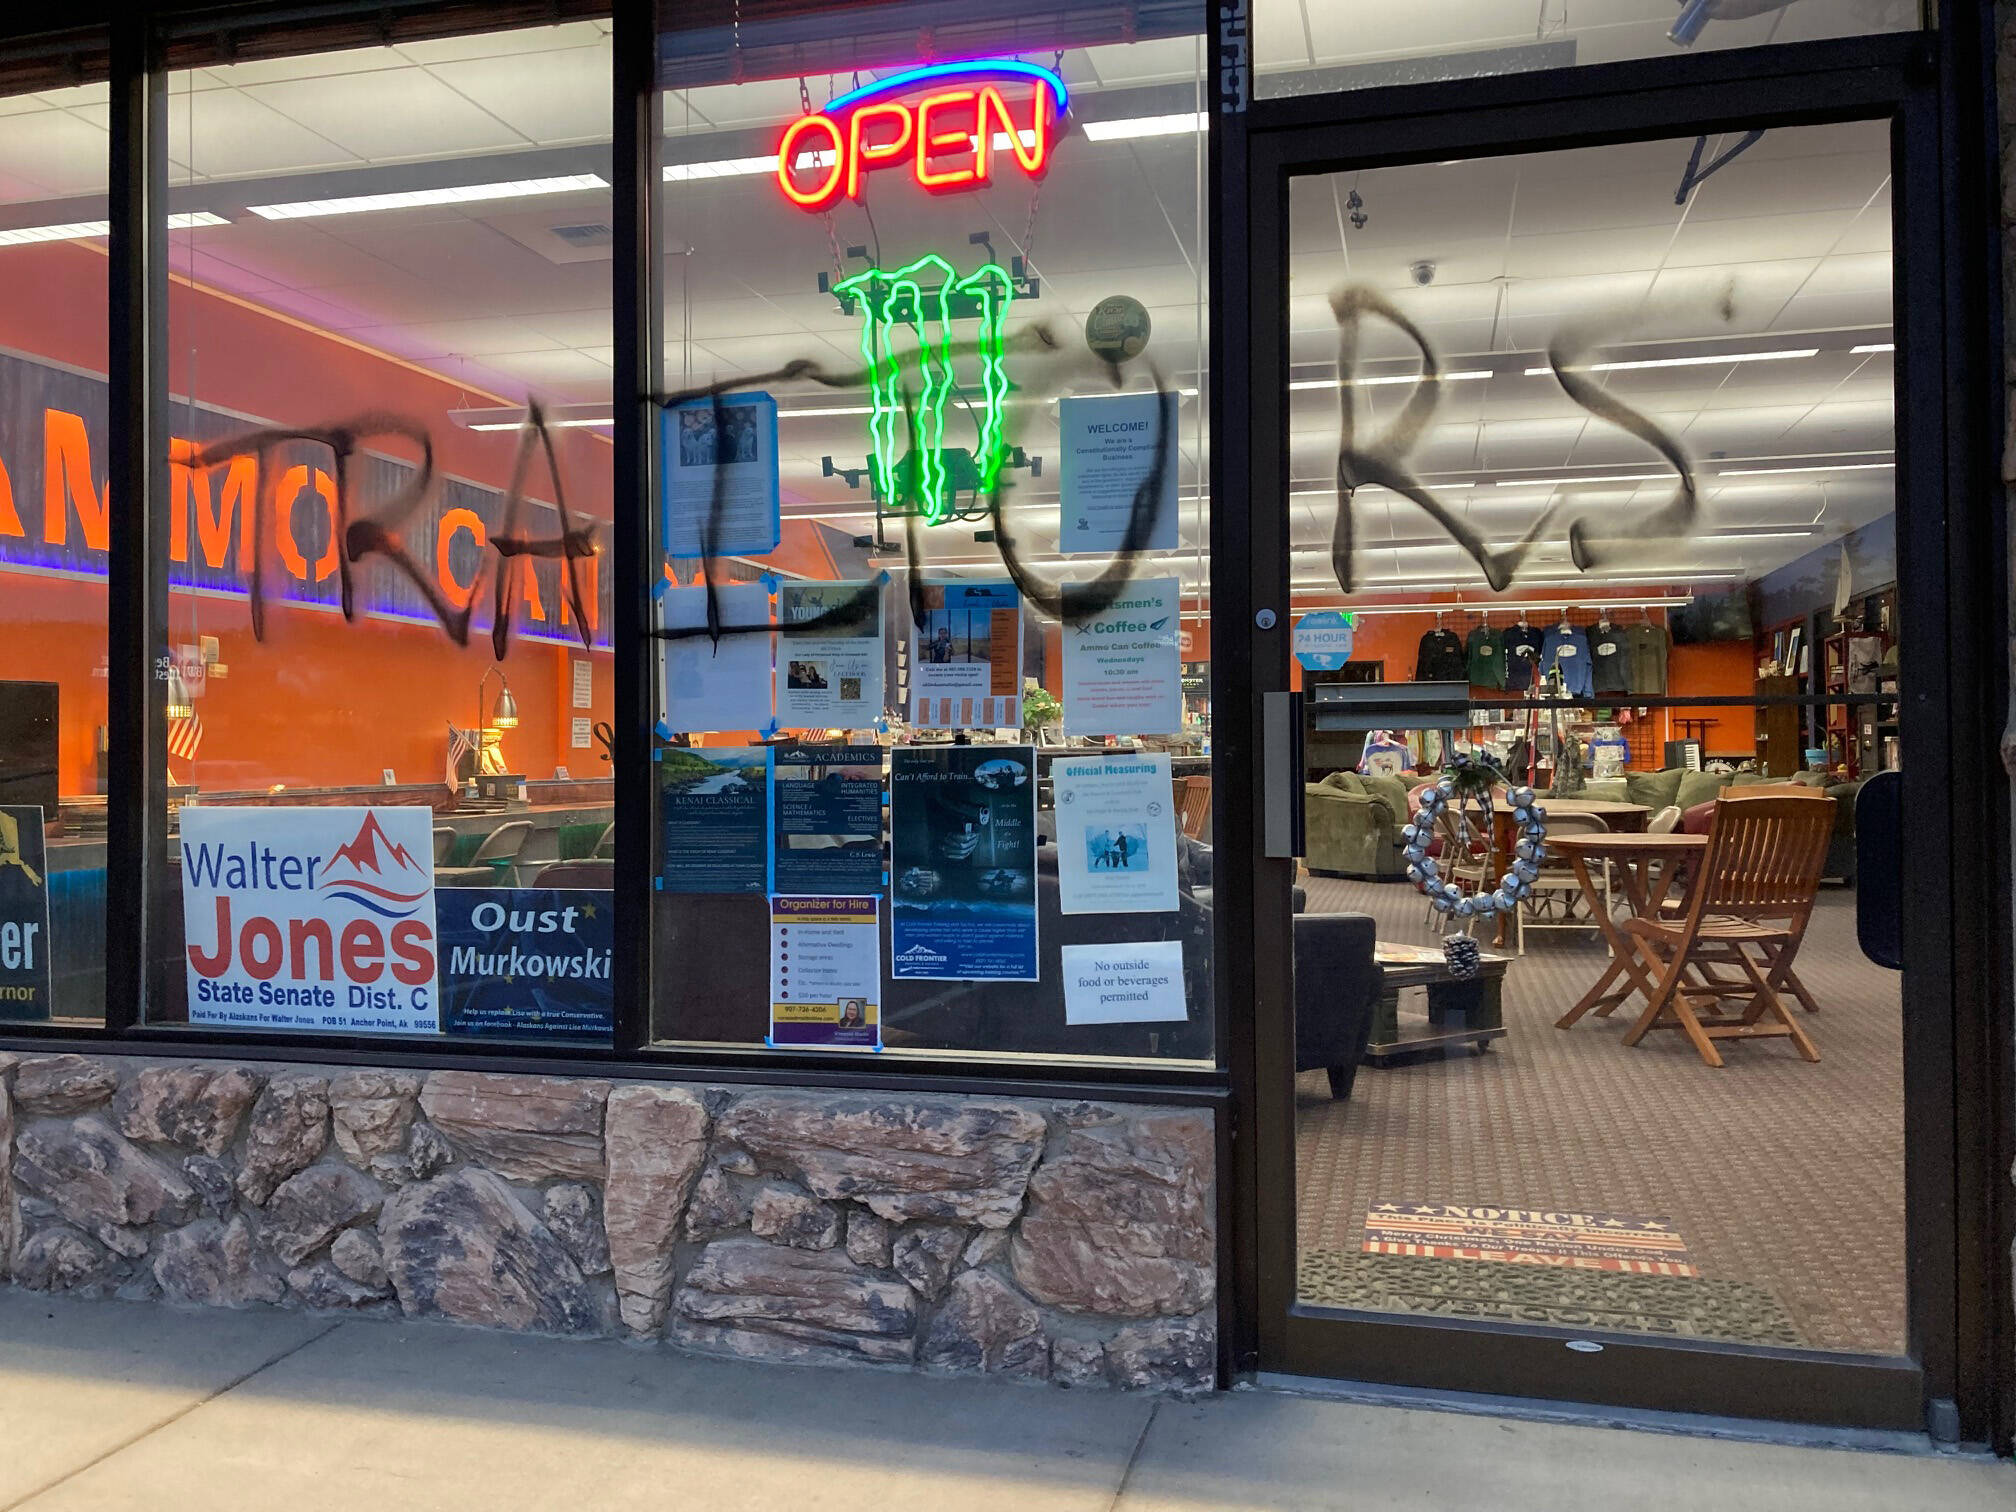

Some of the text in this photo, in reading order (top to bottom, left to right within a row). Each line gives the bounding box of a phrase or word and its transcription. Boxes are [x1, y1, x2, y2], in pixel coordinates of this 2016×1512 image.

[777, 79, 1048, 209] OPEN
[1087, 421, 1149, 434] WELCOME!
[1094, 620, 1147, 634] Coffee
[1298, 632, 1346, 643] 24 HOUR
[1080, 641, 1161, 652] Ammo Can Coffee
[1097, 655, 1145, 664] Wednesdays
[815, 752, 876, 762] ACADEMICS
[895, 772, 915, 781] Can't
[916, 772, 938, 782] Afford
[1066, 764, 1157, 777] Official Measuring
[675, 796, 753, 805] KENAI CLASSICAL
[995, 818, 1022, 827] Middle
[998, 841, 1020, 850] Fight!
[184, 840, 321, 890] Walter
[780, 899, 869, 912] Organizer for Hire
[471, 901, 579, 934] Oust
[187, 895, 435, 985] Jones
[450, 946, 612, 979] Murkowski
[895, 954, 948, 963] COLD FRONTIER
[1095, 960, 1150, 971] No outside
[1078, 975, 1169, 988] food or beverages
[198, 978, 429, 1011] State Senate Dist. C
[1100, 990, 1149, 1005] permitted
[192, 1010, 437, 1030] Paid For By Alaskans For Walter Jones POB 51 Anchor Point, Ak 99556
[464, 1008, 478, 1016] Help
[487, 1009, 511, 1017] replace
[561, 1011, 605, 1019] Conservative.
[453, 1019, 467, 1027] Join
[484, 1020, 512, 1028] facebook
[516, 1022, 544, 1030] Alaskans
[544, 1023, 568, 1031] Against
[568, 1023, 581, 1031] Lisa
[1443, 1205, 1597, 1228] NOTICE
[1375, 1213, 1411, 1221] This
[1417, 1216, 1466, 1225] Place
[1492, 1220, 1579, 1234] Politically
[1586, 1226, 1670, 1240] Incorrect
[1462, 1225, 1580, 1242] WE SAY
[1381, 1229, 1669, 1257] Merry Christmas, One Nation Under God,
[1383, 1235, 1412, 1244] Give
[1415, 1238, 1459, 1248] Thanks
[1462, 1241, 1478, 1249] To
[1481, 1243, 1505, 1251] Our
[1569, 1250, 1600, 1258] This
[1603, 1251, 1655, 1262] Offends
[1453, 1247, 1603, 1270] LEAVE
